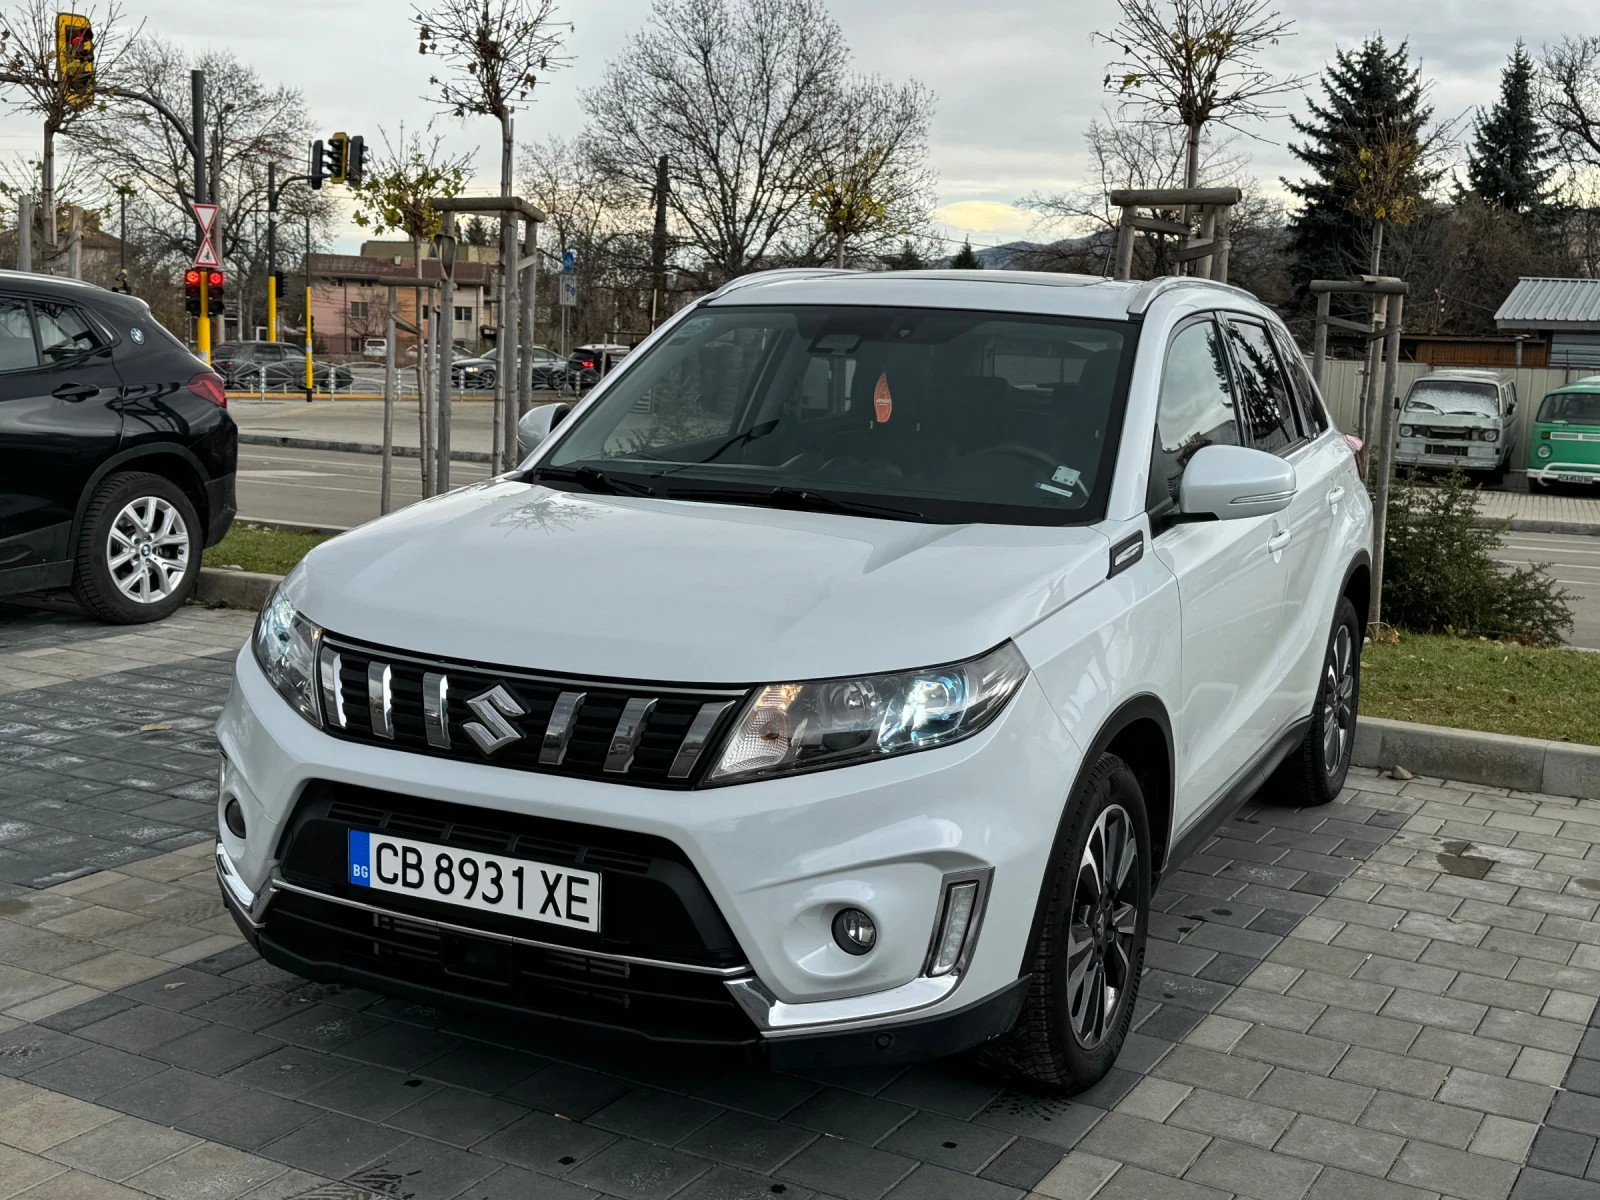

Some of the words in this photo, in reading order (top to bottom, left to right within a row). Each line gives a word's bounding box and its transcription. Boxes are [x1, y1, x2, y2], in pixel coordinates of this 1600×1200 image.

[353, 863, 369, 879] BG
[375, 841, 425, 890] CB
[433, 852, 525, 911] 8931
[538, 869, 590, 924] XE
